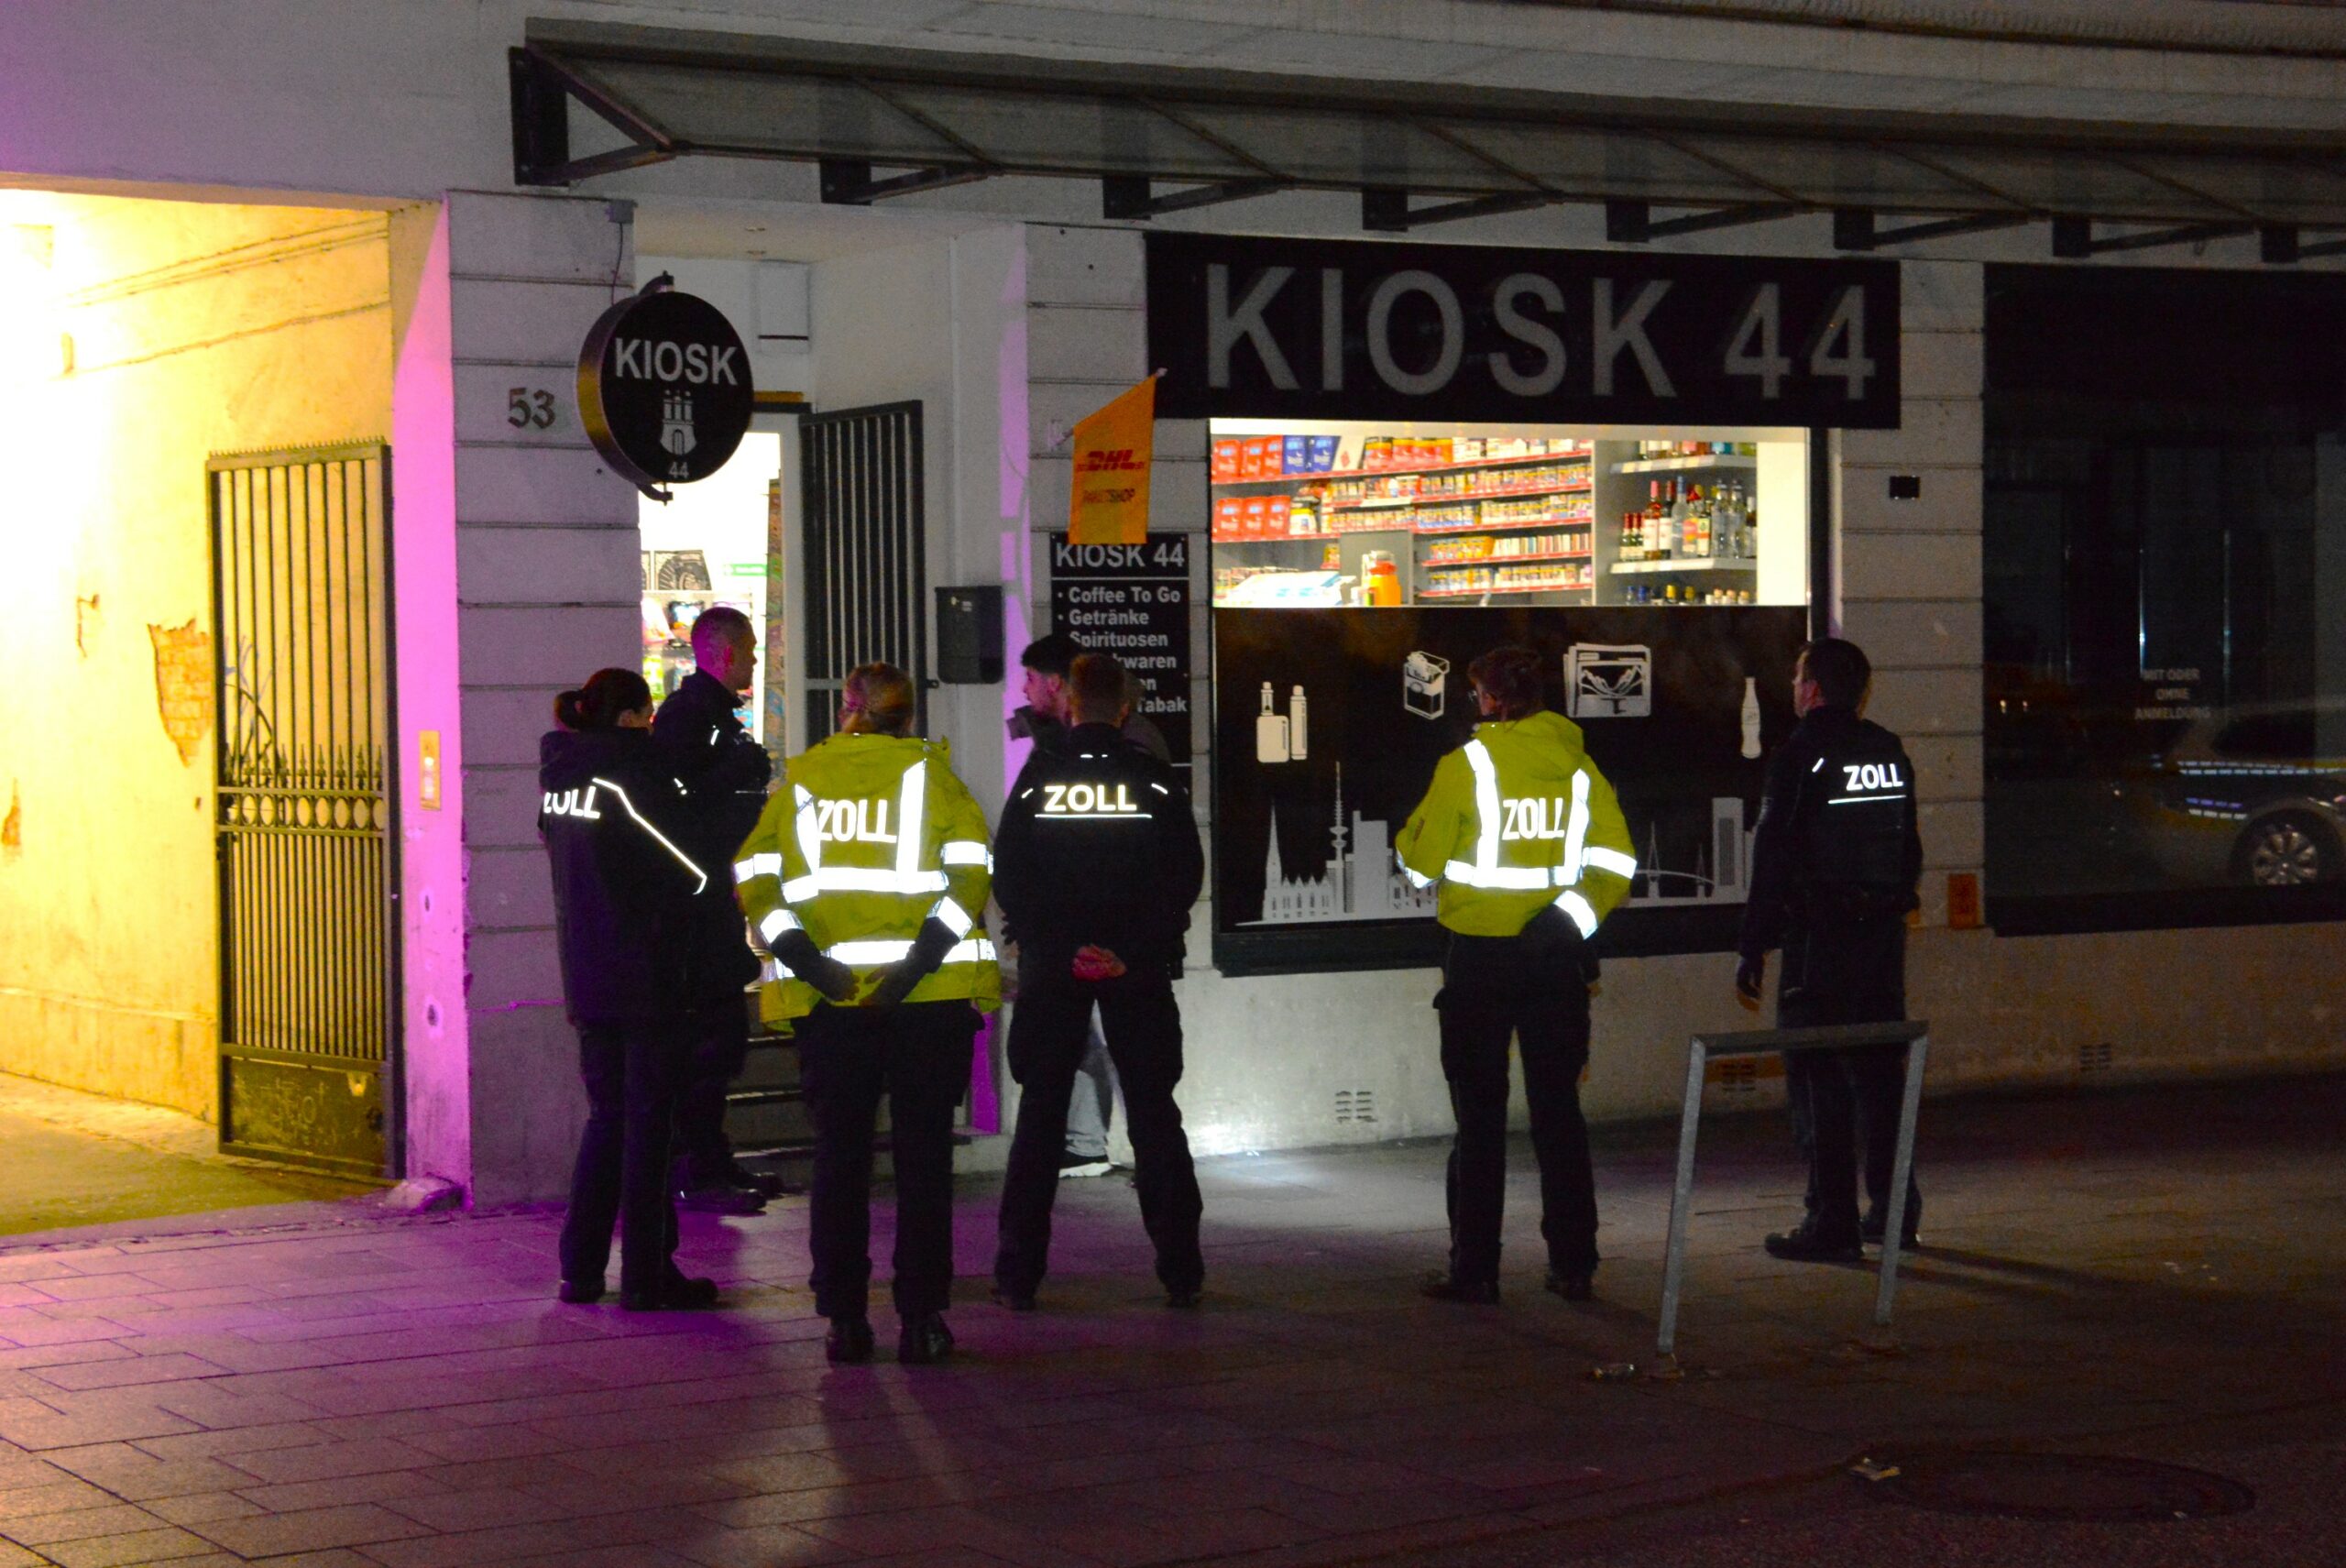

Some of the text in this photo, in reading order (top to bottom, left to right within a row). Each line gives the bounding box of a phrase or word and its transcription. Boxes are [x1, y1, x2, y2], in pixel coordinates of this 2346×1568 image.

[1205, 263, 1877, 401] KIOSK 44
[614, 337, 738, 387] KIOSK
[508, 388, 556, 430] 53
[667, 462, 690, 479] 44
[1087, 449, 1136, 471] DHL
[1056, 542, 1185, 568] KIOSK 44
[1069, 586, 1181, 603] Coffee To Go
[1069, 609, 1150, 626] Getränke
[1069, 630, 1169, 648] Spirituosen
[1843, 762, 1904, 792] ZOLL
[1044, 784, 1137, 812] ZOLL
[817, 799, 898, 843] ZOLL
[1502, 797, 1565, 840] ZOLL
